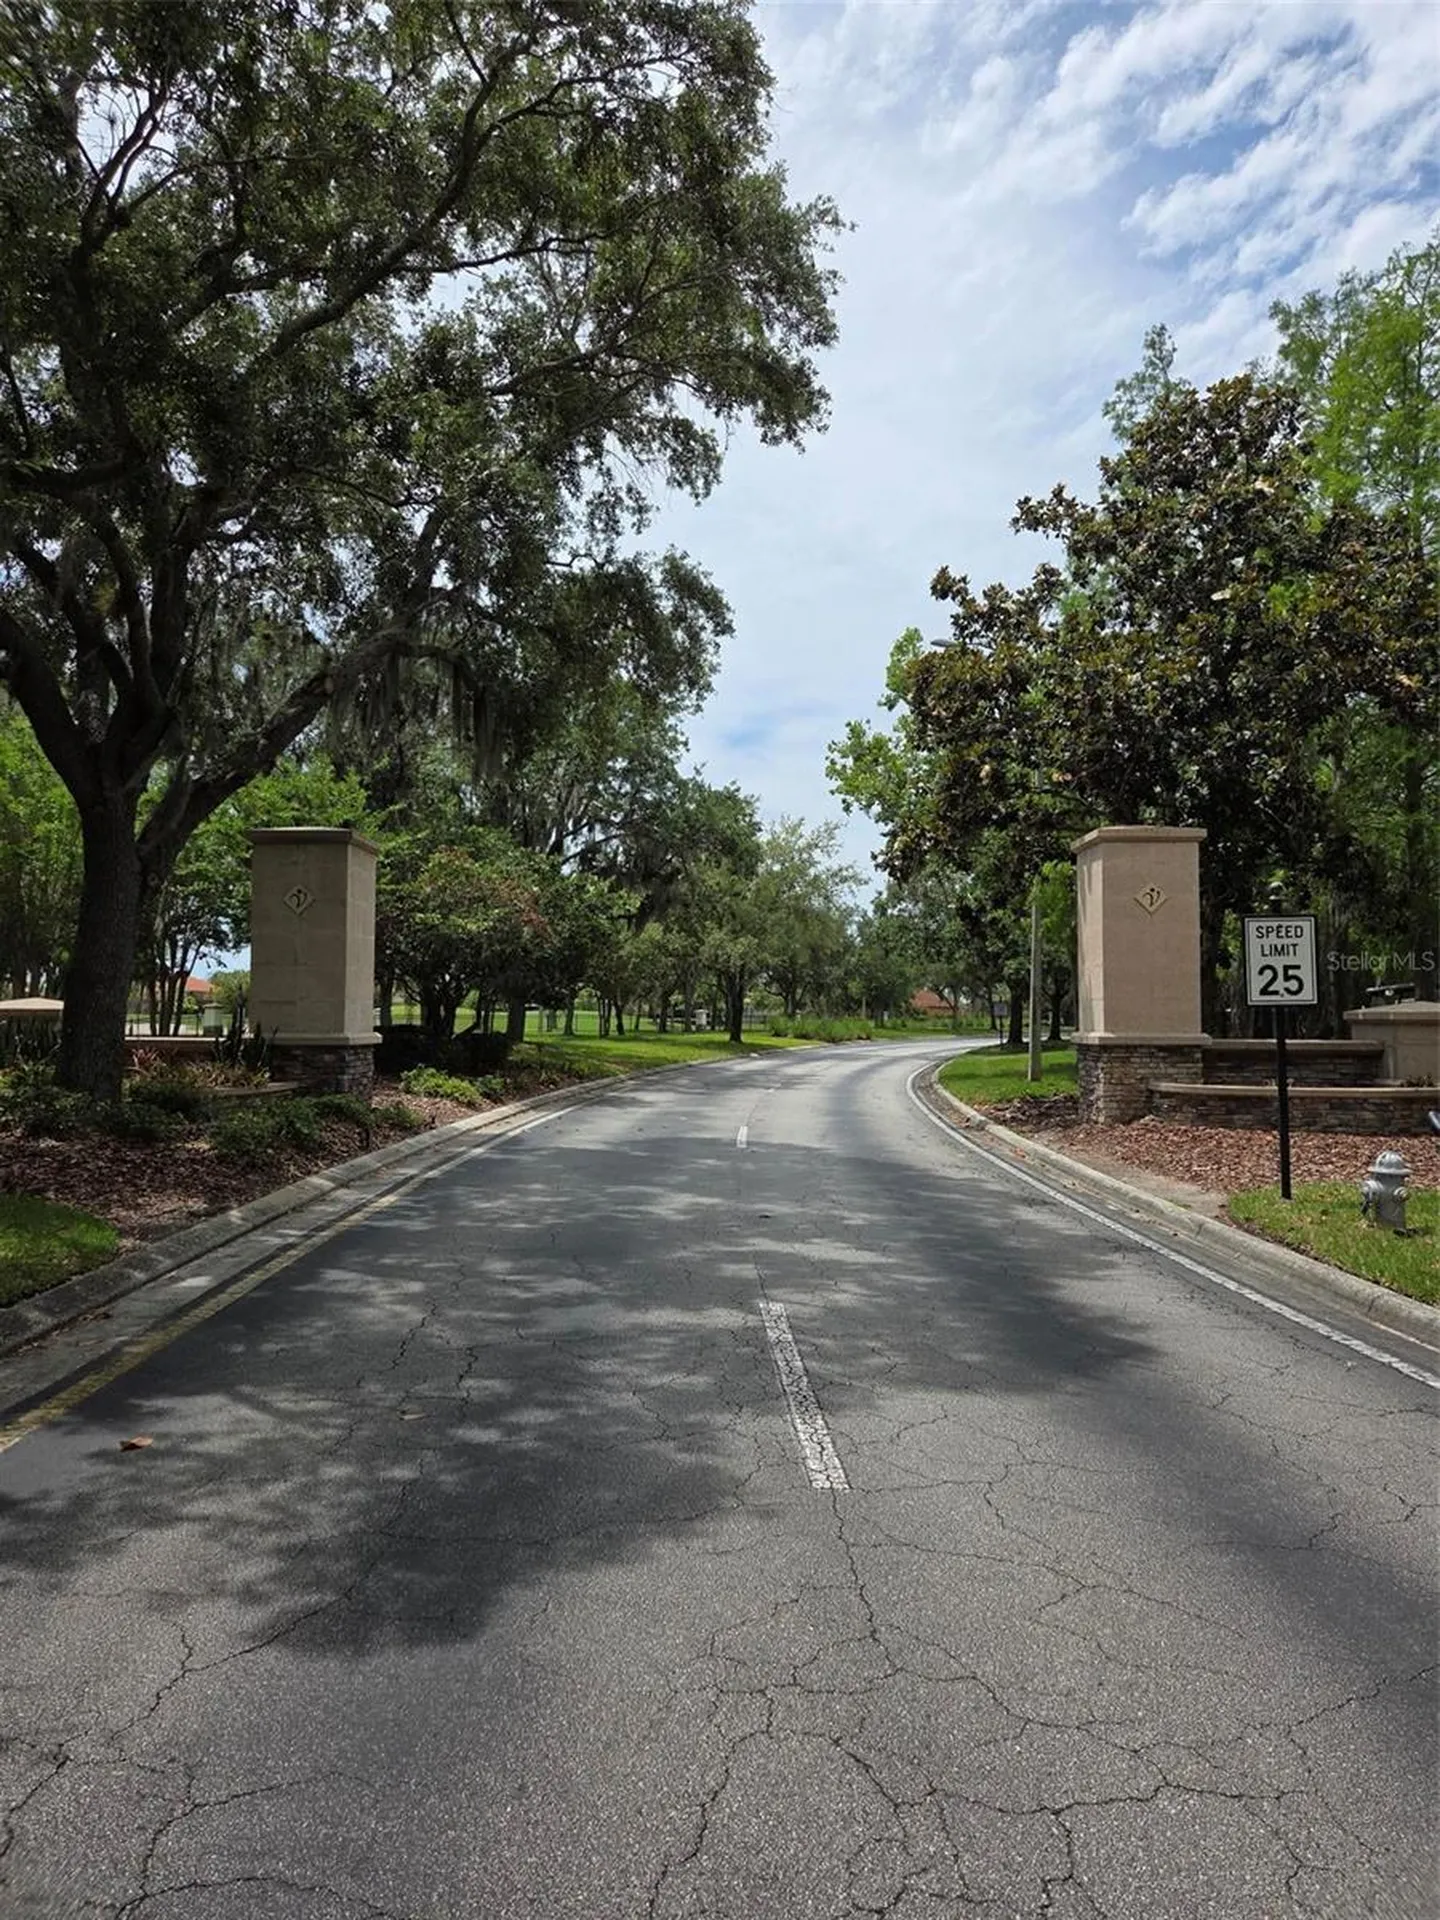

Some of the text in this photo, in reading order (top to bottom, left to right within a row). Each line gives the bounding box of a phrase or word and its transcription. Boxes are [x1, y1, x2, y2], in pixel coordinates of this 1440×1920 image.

[1255, 925, 1304, 939] SPEED
[1260, 943, 1299, 958] LIMIT
[1257, 964, 1305, 996] 25
